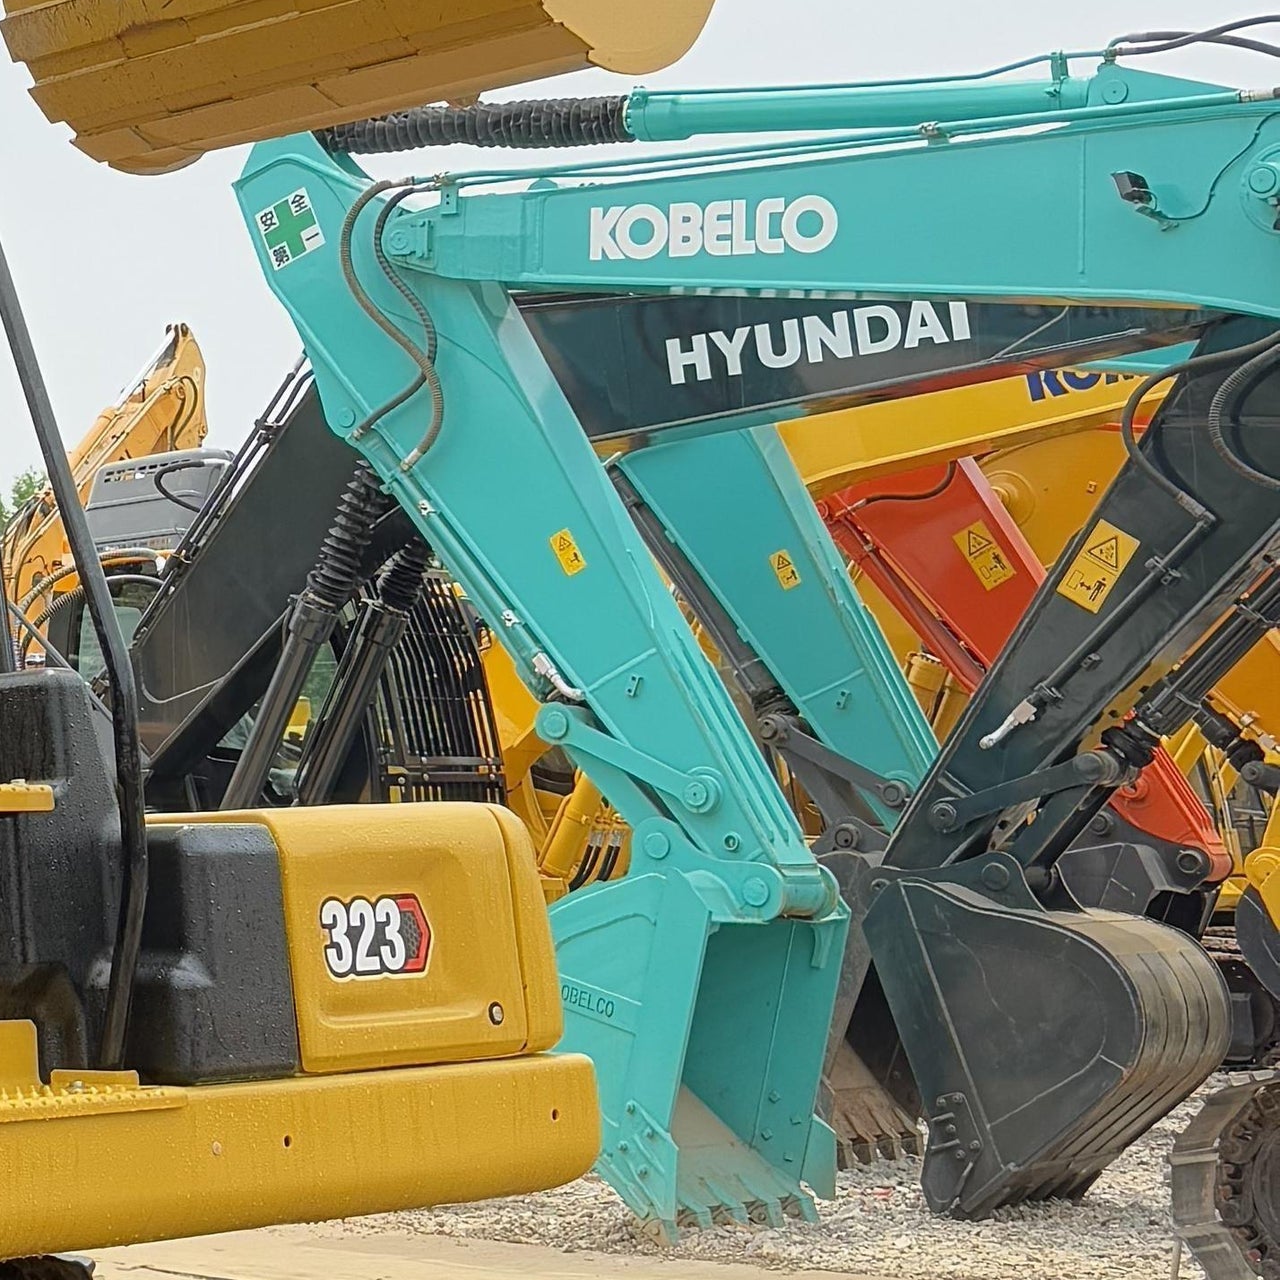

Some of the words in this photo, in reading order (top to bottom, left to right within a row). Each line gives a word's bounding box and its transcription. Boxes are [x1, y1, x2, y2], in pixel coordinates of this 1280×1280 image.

[589, 194, 839, 261] KOBELCO
[665, 300, 972, 385] HYUNDAI
[321, 898, 406, 973] 323
[560, 983, 615, 1019] OBELCO
